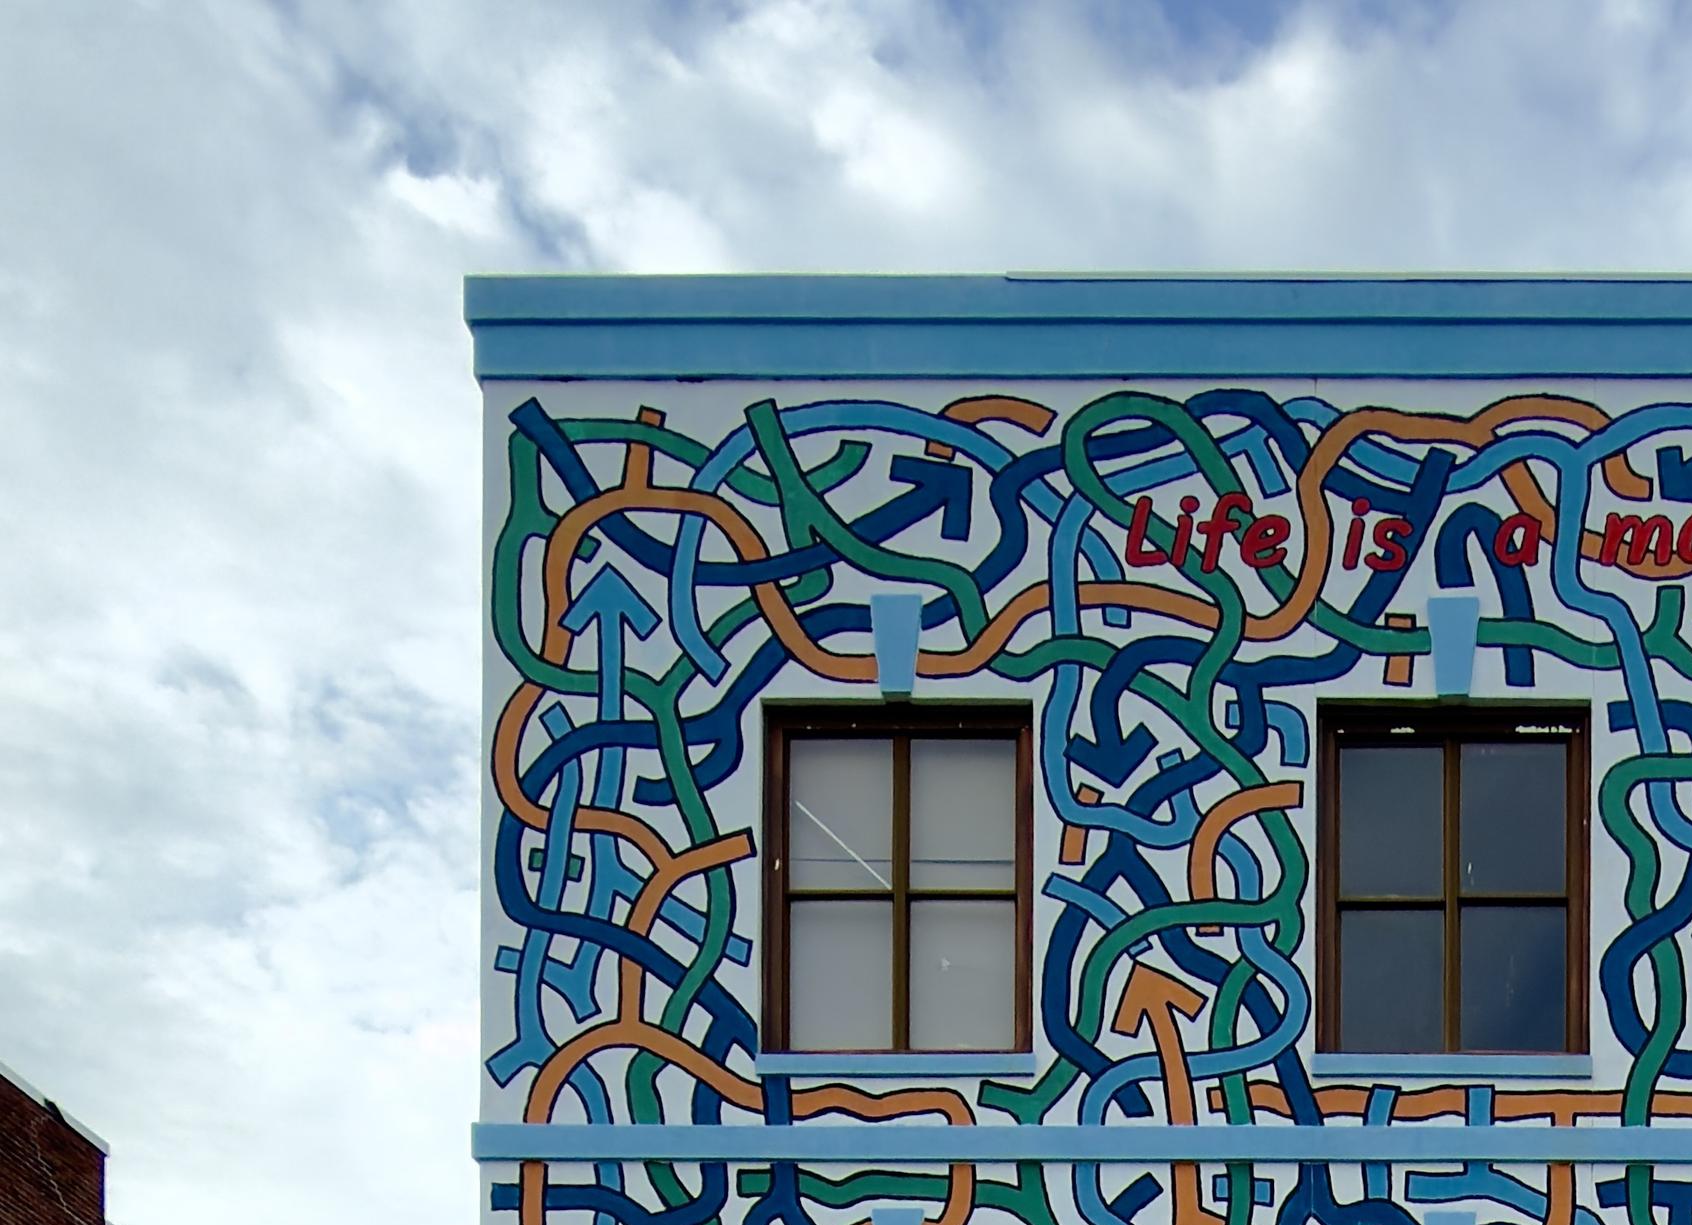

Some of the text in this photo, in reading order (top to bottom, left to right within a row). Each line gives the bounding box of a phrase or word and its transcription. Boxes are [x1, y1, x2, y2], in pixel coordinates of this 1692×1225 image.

[1125, 492, 1290, 572] Life
[1343, 498, 1412, 570] is
[1494, 513, 1541, 566] a
